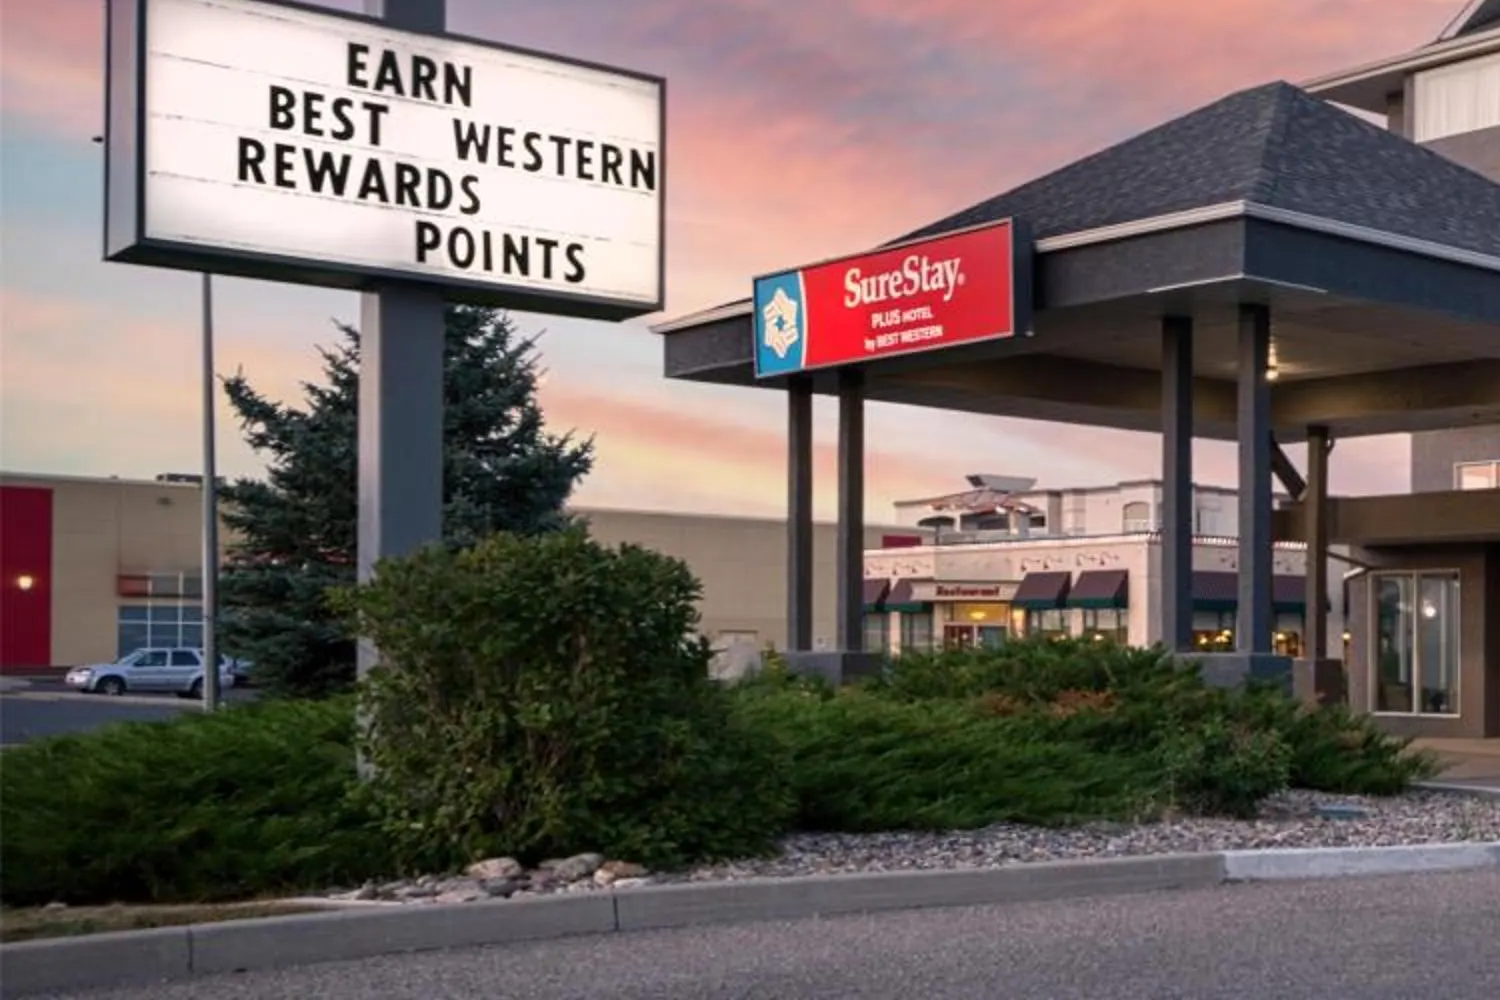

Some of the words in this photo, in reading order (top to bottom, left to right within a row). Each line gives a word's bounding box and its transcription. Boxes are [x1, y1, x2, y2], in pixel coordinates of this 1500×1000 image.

[347, 43, 472, 107] EARN
[269, 85, 388, 145] BEST
[453, 118, 656, 190] WESTERN
[238, 137, 481, 215] REWARDS
[415, 221, 586, 283] POINTS
[871, 309, 900, 329] PLUS
